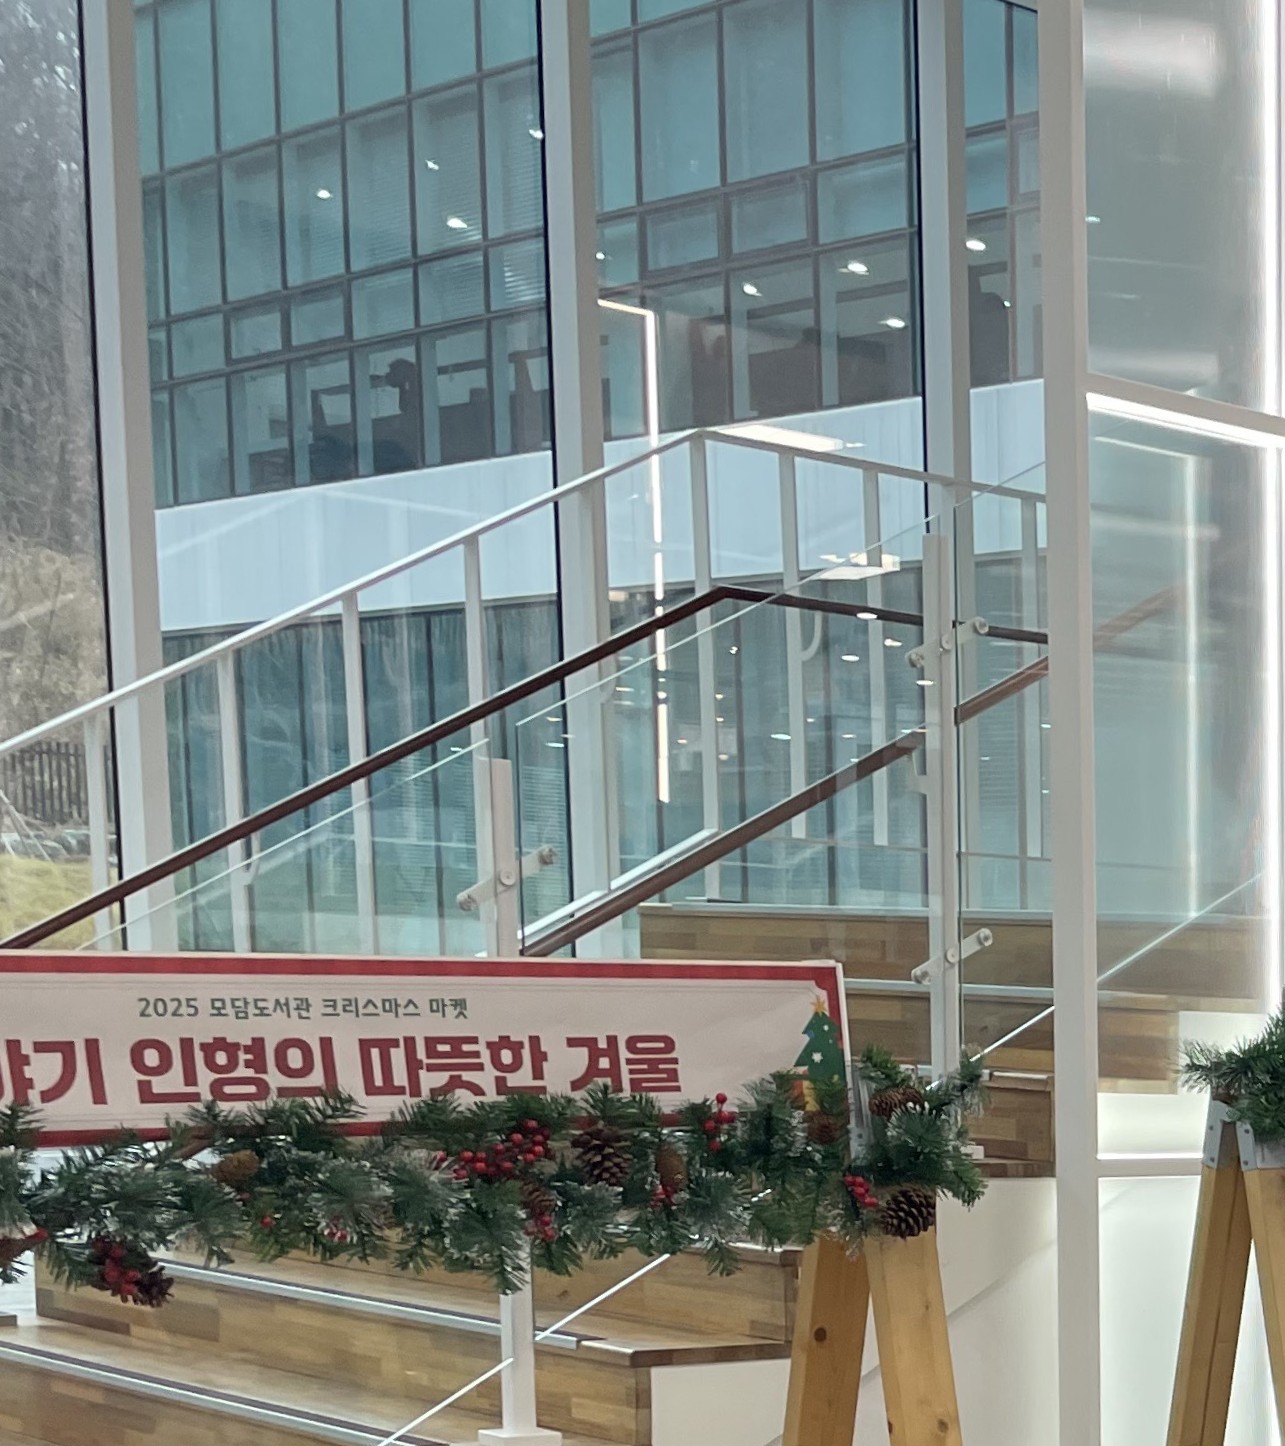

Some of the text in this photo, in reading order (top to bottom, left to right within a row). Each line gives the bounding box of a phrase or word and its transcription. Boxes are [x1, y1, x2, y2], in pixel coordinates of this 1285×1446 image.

[138, 997, 469, 1020] 2025 모담도서관 크리스마스 마켓
[129, 1036, 339, 1104] 인형의
[358, 1034, 548, 1098] 따뜻한
[566, 1034, 682, 1094] 겨울
